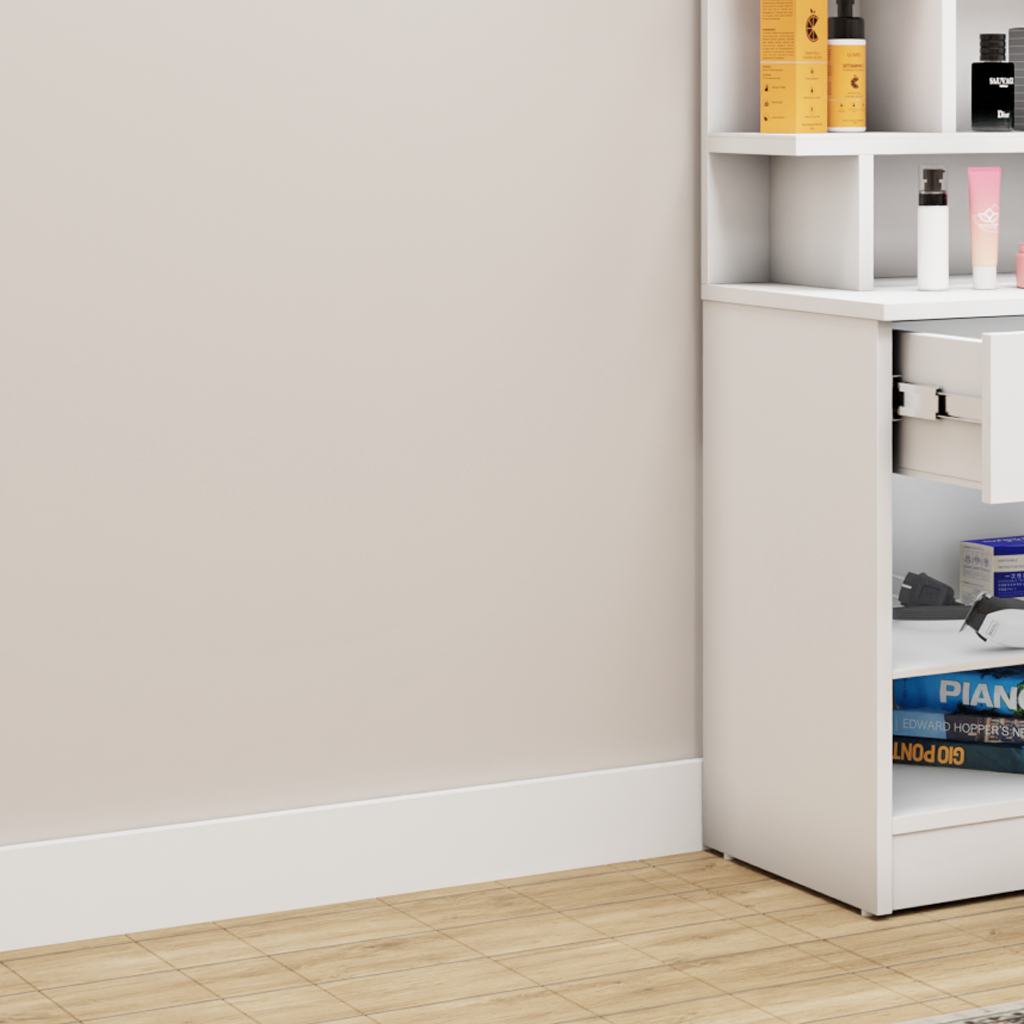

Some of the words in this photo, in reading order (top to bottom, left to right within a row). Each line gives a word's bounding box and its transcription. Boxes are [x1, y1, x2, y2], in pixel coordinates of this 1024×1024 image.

[997, 109, 1010, 119] Dior
[903, 718, 951, 732] EDWARD
[954, 722, 1009, 737] HOPPER'S
[937, 745, 965, 766] GIO
